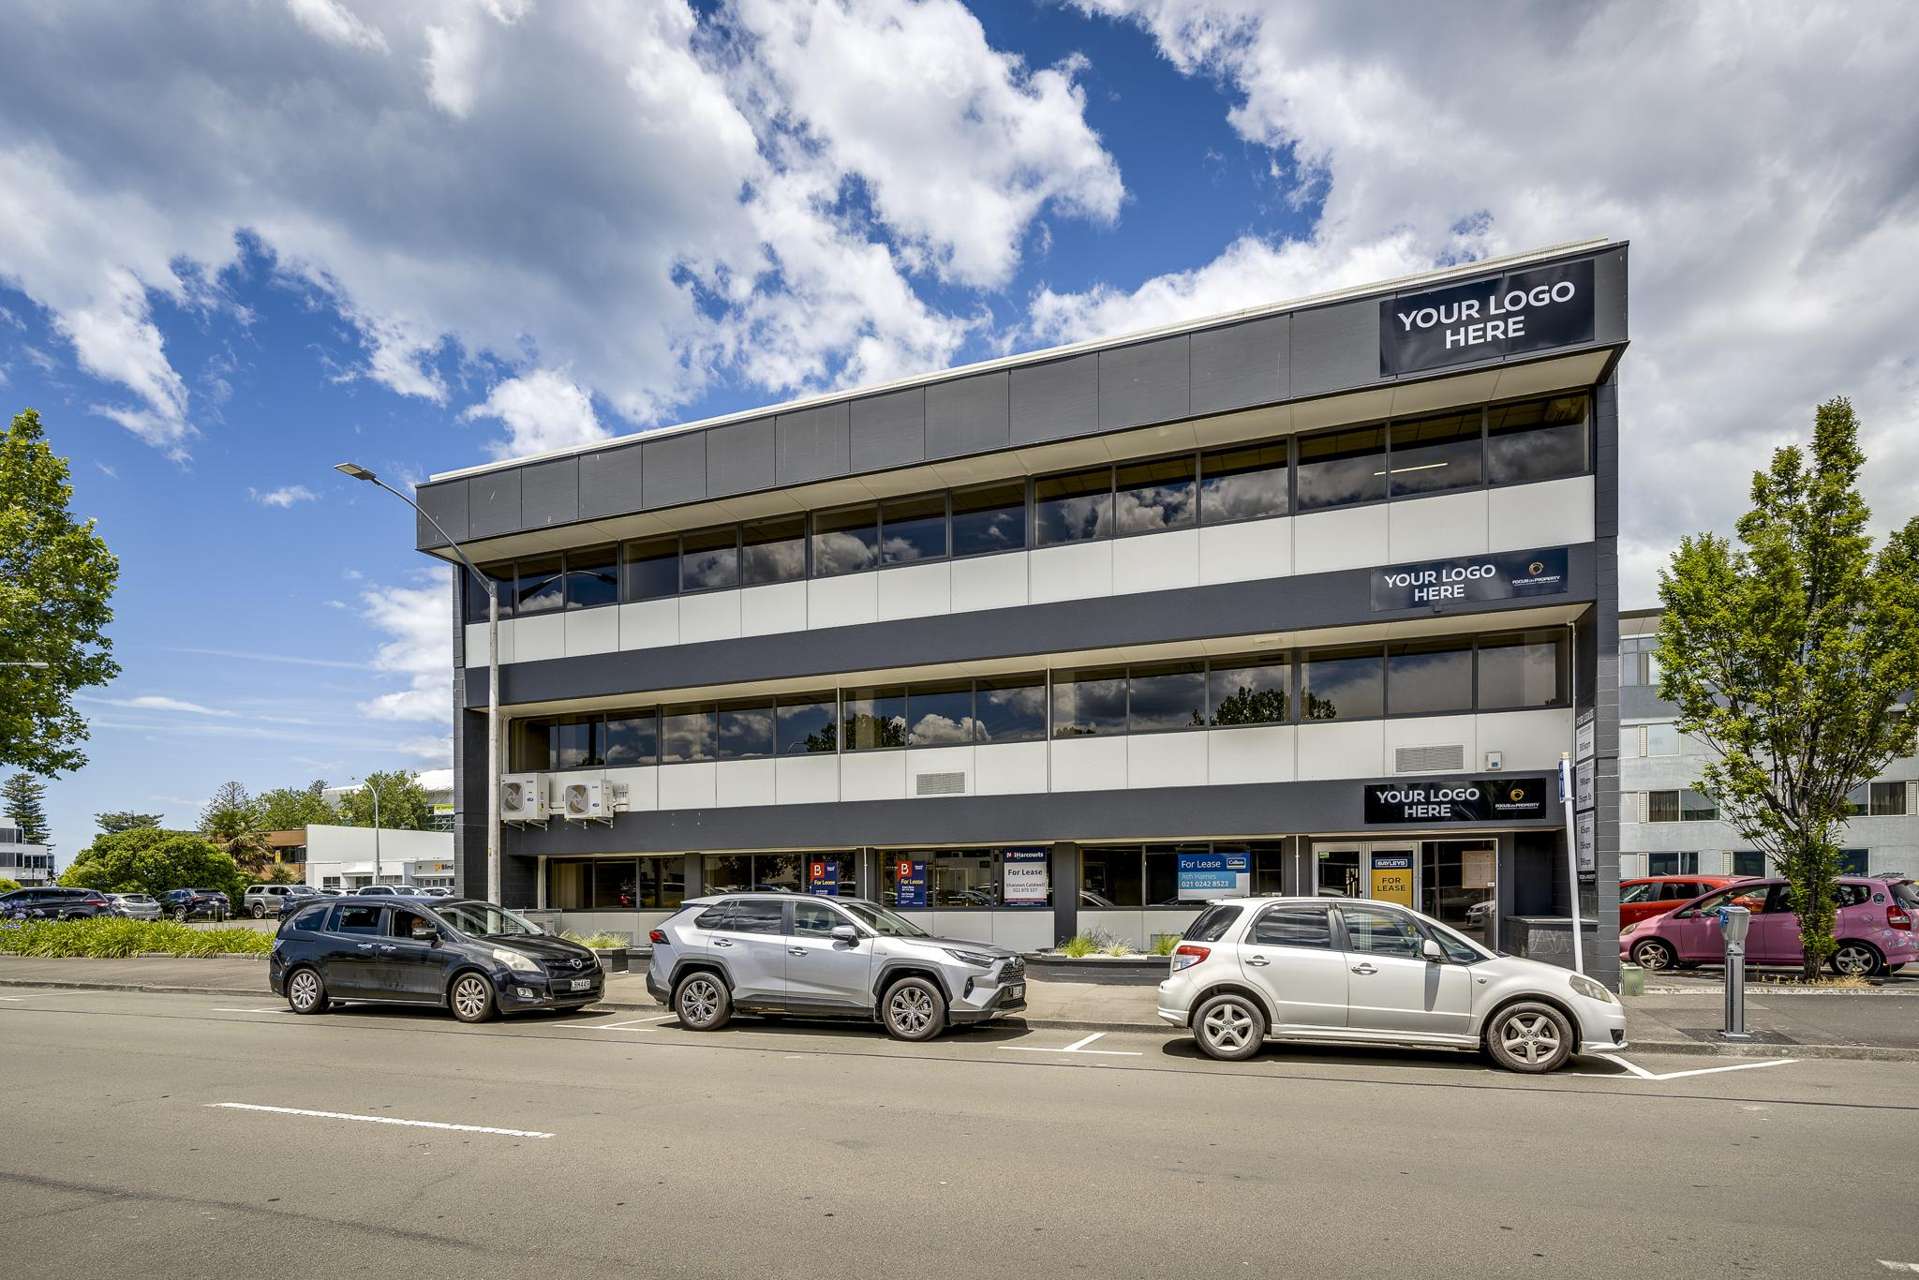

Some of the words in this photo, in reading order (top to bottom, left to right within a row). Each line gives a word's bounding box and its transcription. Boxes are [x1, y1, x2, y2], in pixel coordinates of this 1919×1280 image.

[1398, 299, 1481, 331] YOUR
[1489, 281, 1576, 316] LOGO
[1445, 315, 1526, 350] HERE
[1384, 570, 1437, 588] YOUR
[1442, 564, 1496, 582] LOGO
[1414, 584, 1465, 602] HERE
[1376, 790, 1425, 804] YOUR
[1430, 788, 1480, 802] LOGO
[1404, 804, 1451, 818] HERE
[814, 864, 822, 876] B
[901, 863, 909, 875] B
[1181, 860, 1196, 869] For
[1197, 860, 1221, 869] Lease
